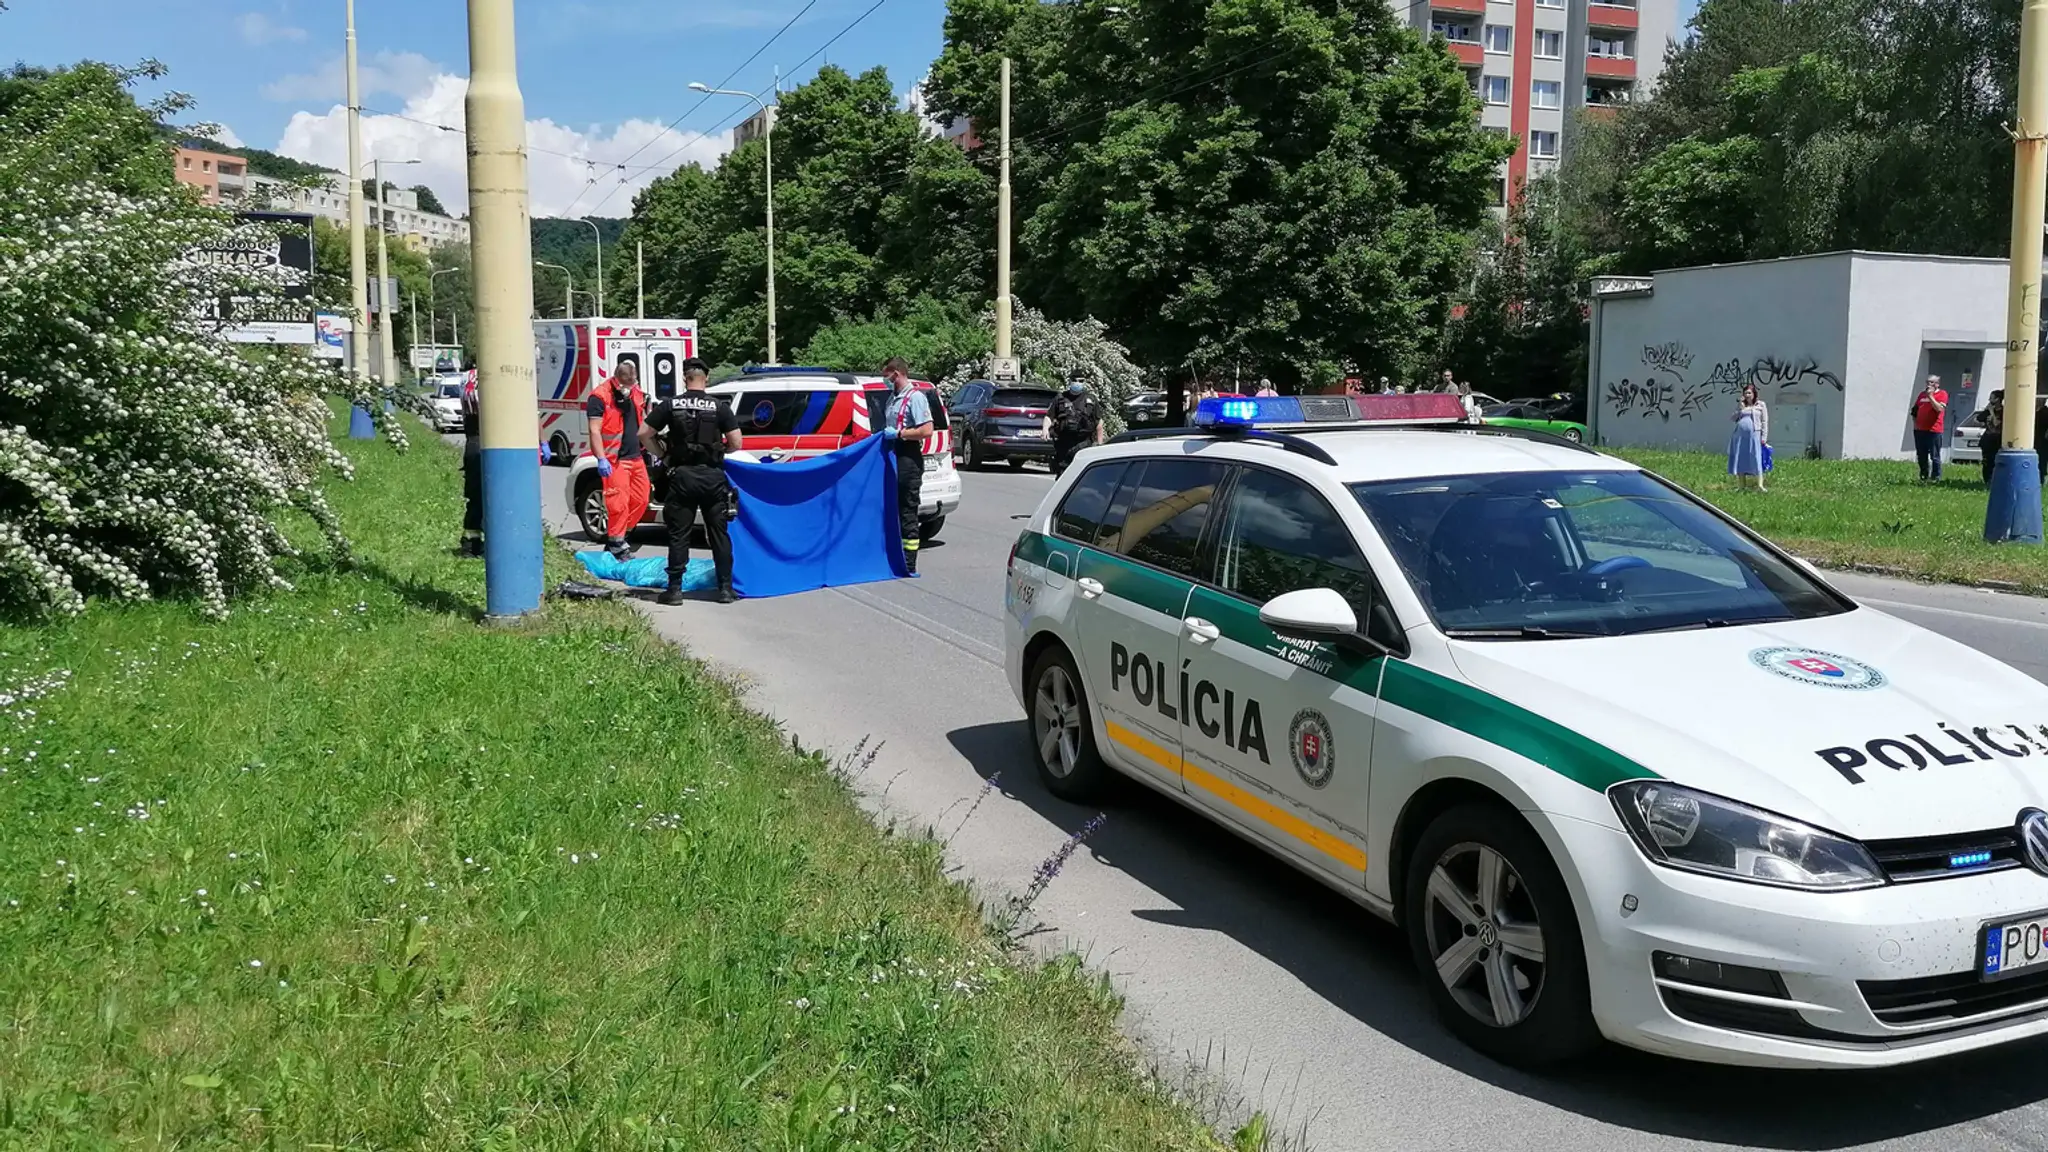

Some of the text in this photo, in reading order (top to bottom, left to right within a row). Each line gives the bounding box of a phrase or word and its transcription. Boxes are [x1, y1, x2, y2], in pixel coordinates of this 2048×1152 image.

[610, 341, 622, 350] 62
[672, 397, 717, 410] POLÍCIA
[1110, 640, 1271, 766] POLÍCIA
[2003, 922, 2041, 967] PO
[1986, 954, 1998, 967] SK
